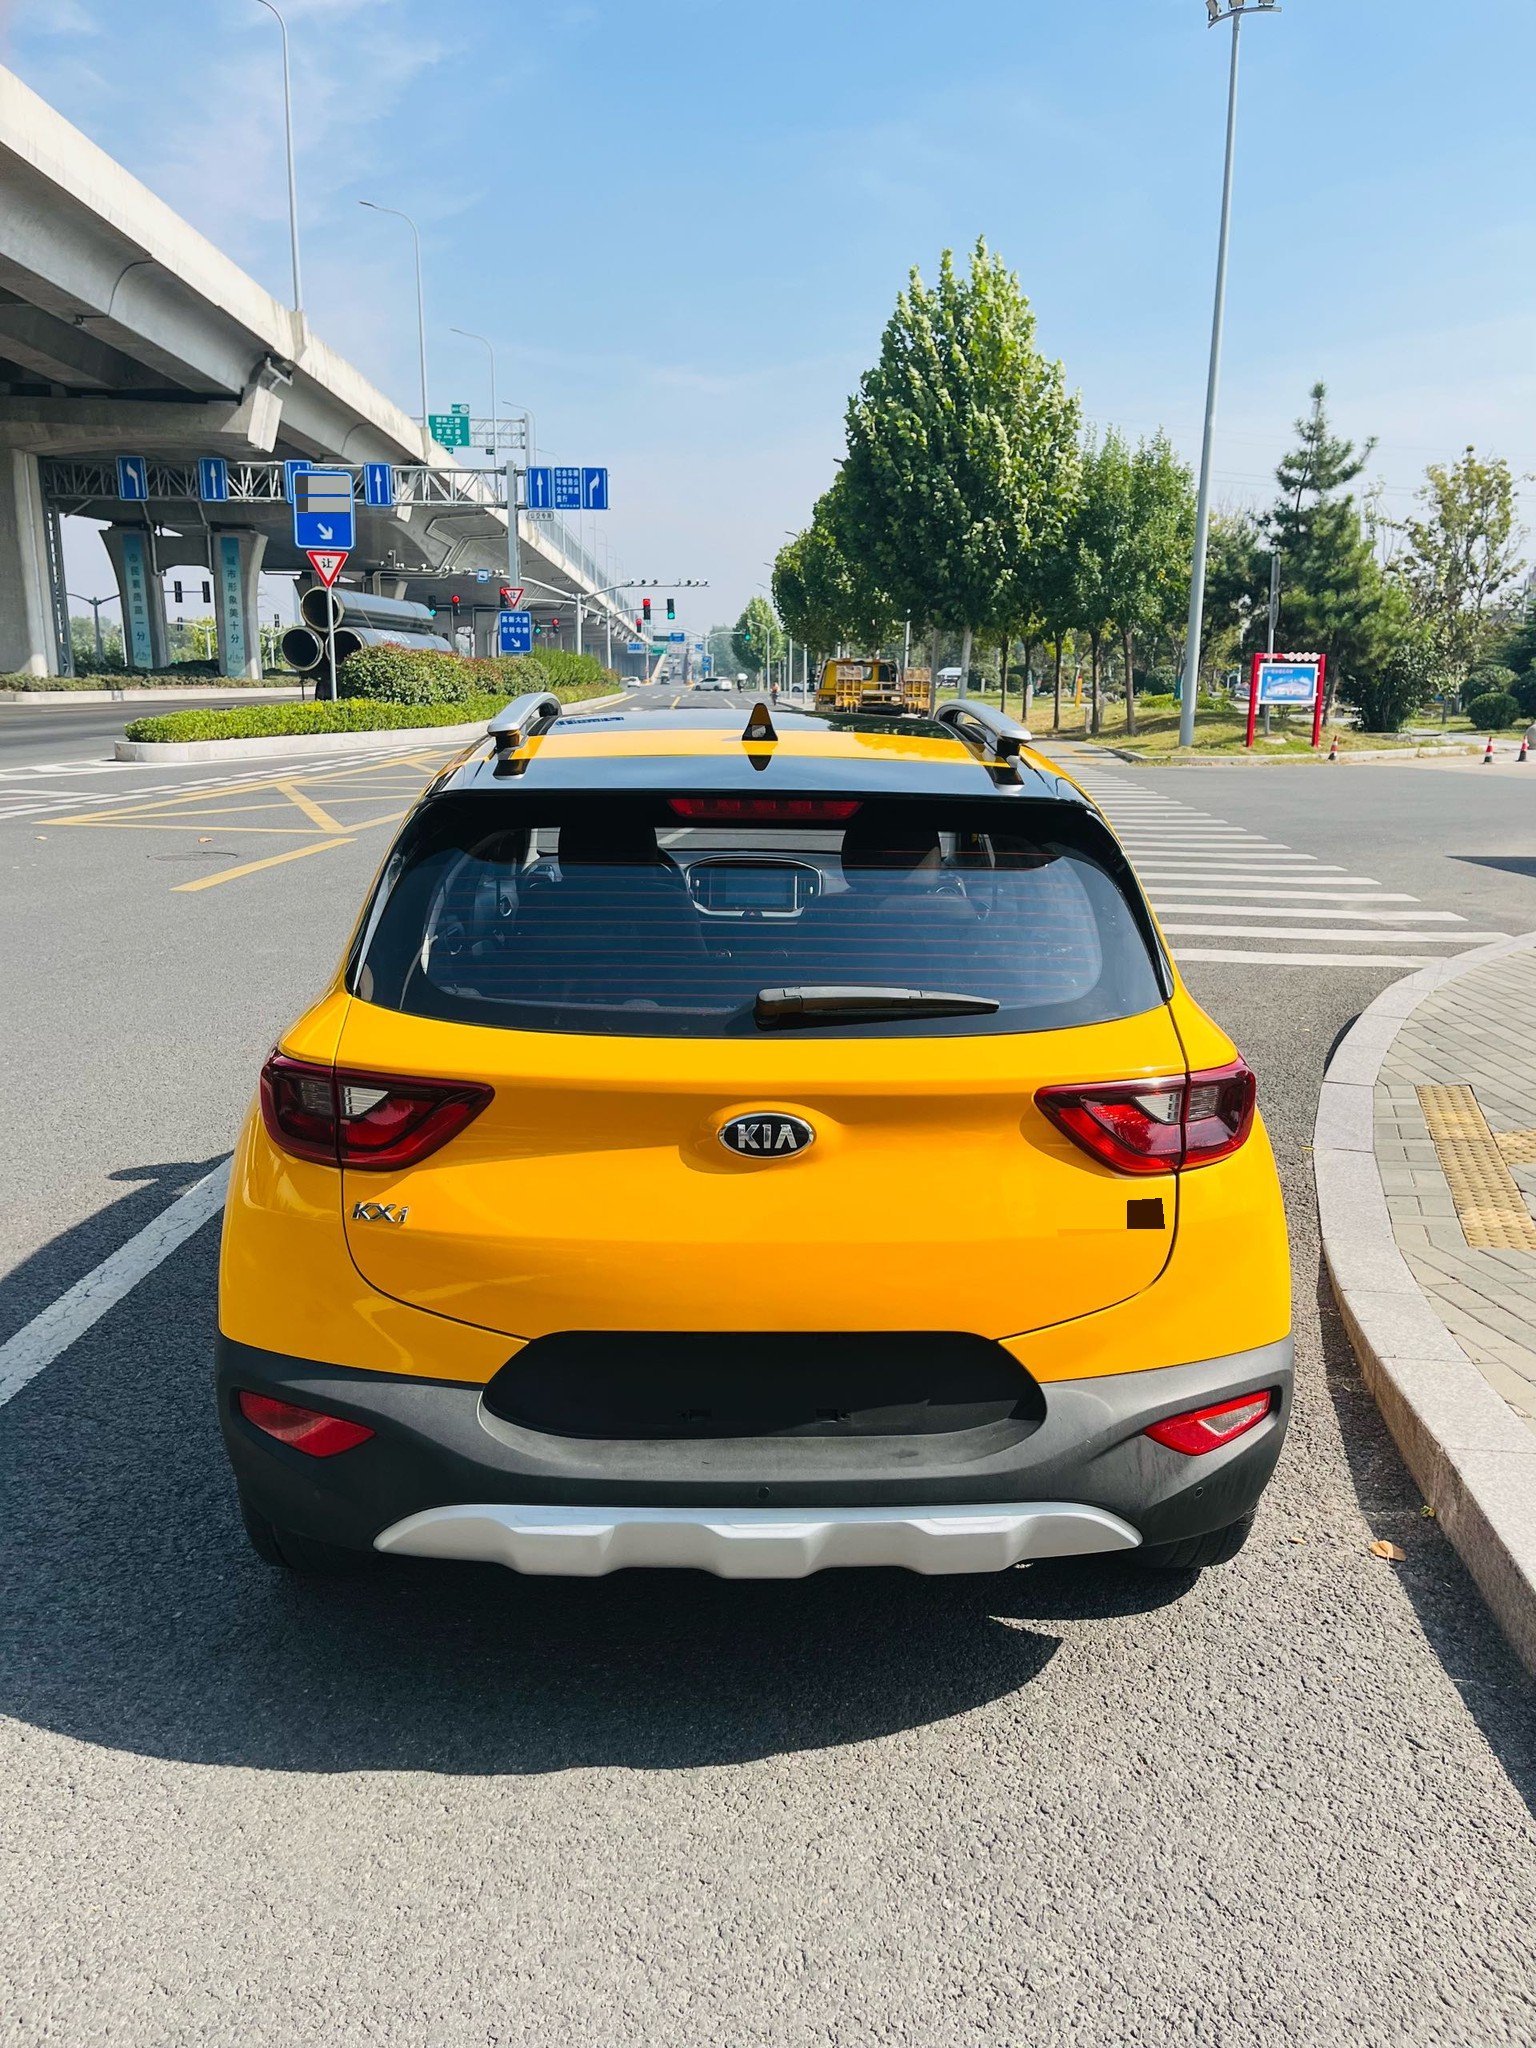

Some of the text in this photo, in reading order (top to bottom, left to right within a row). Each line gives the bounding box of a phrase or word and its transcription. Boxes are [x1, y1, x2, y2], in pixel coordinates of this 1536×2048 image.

[321, 558, 333, 569] 让
[226, 555, 241, 644] 城市形象美十分
[509, 591, 517, 599] 让
[737, 1123, 798, 1149] KIA
